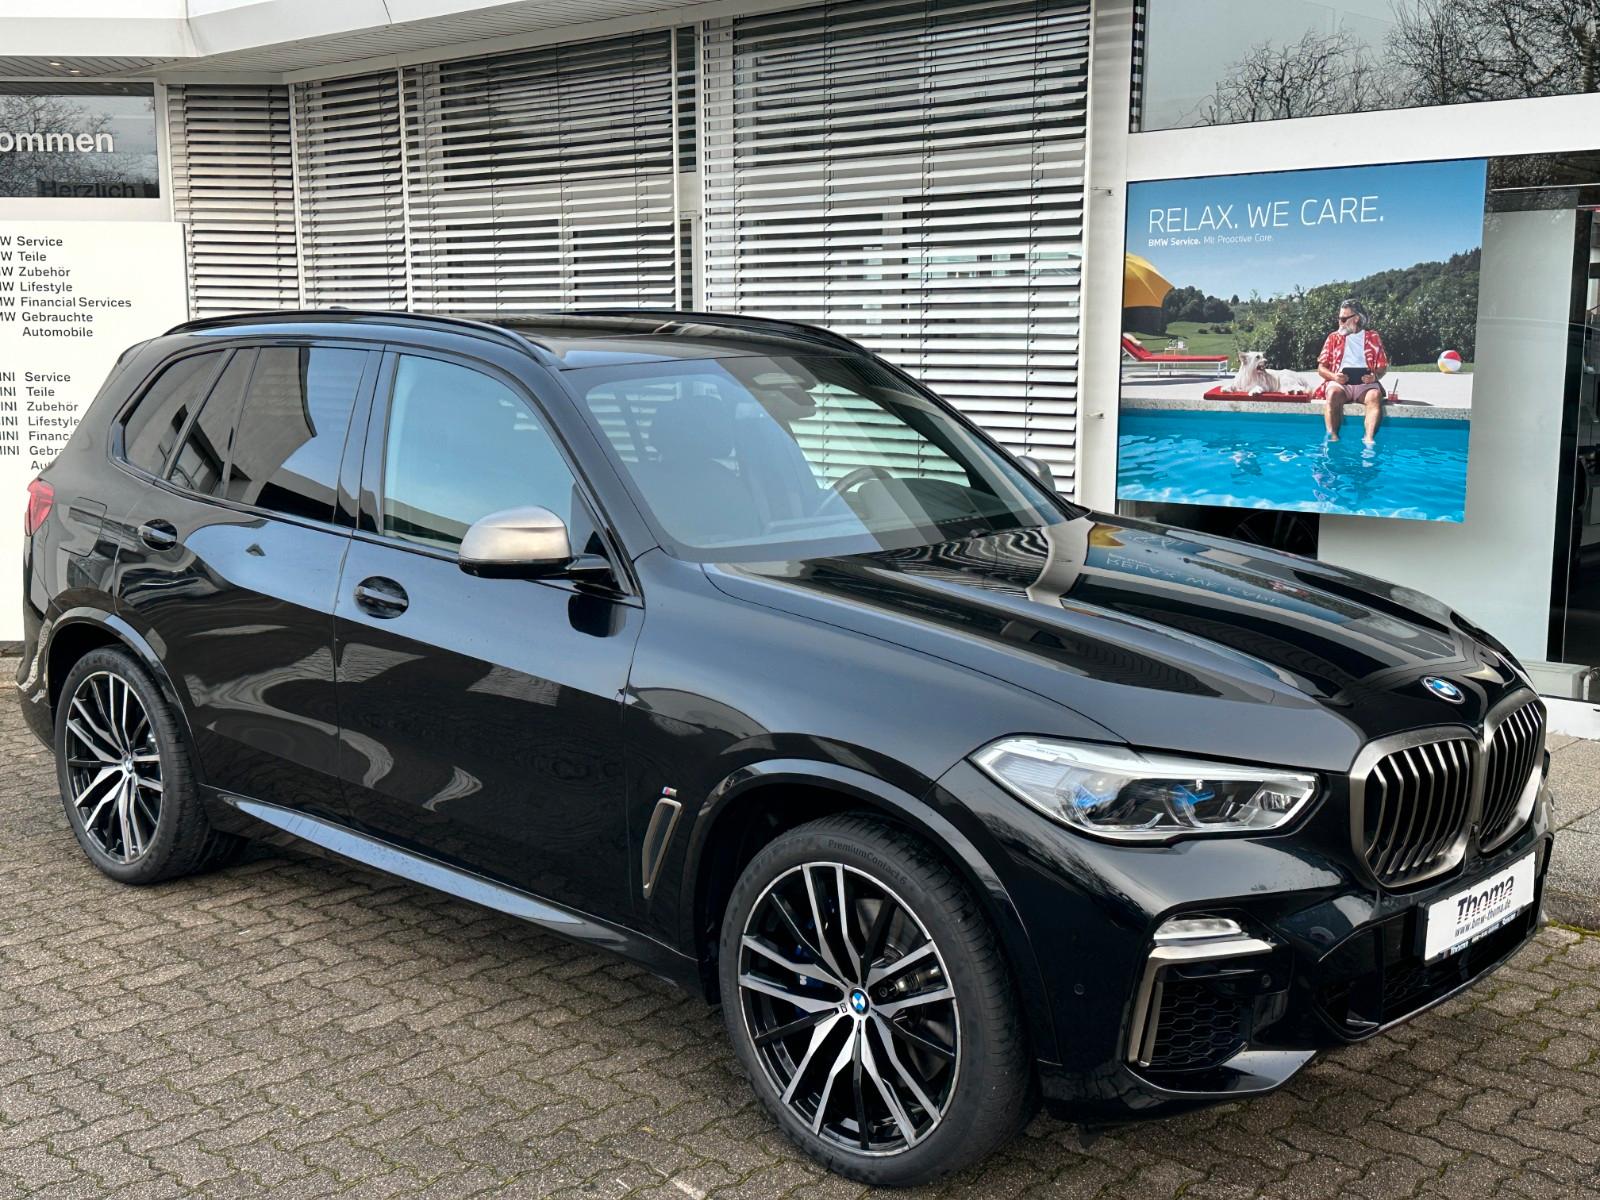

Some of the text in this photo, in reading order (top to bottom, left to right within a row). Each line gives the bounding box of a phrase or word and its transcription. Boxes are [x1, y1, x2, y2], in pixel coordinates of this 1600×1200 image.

[1148, 195, 1384, 233] RELAX. WE CARE.
[17, 236, 63, 247] Service
[1148, 238, 1169, 247] BMW
[1170, 237, 1201, 246] Service.
[1217, 235, 1253, 244] Proactive
[17, 251, 47, 262] Teile
[18, 266, 71, 277] Zubehör
[20, 281, 73, 294] Lifestyle
[20, 296, 76, 307] Financial
[79, 297, 132, 308] Services
[22, 312, 94, 322] Gebrauchte
[22, 327, 94, 337] Automobile
[25, 372, 71, 382] Service
[26, 386, 55, 397] Teile
[26, 401, 79, 412] Zubehör
[0, 416, 80, 428] INI Lifestyle
[0, 431, 19, 441] INI
[828, 839, 900, 878] PremiumContact
[1457, 875, 1514, 924] Thoma
